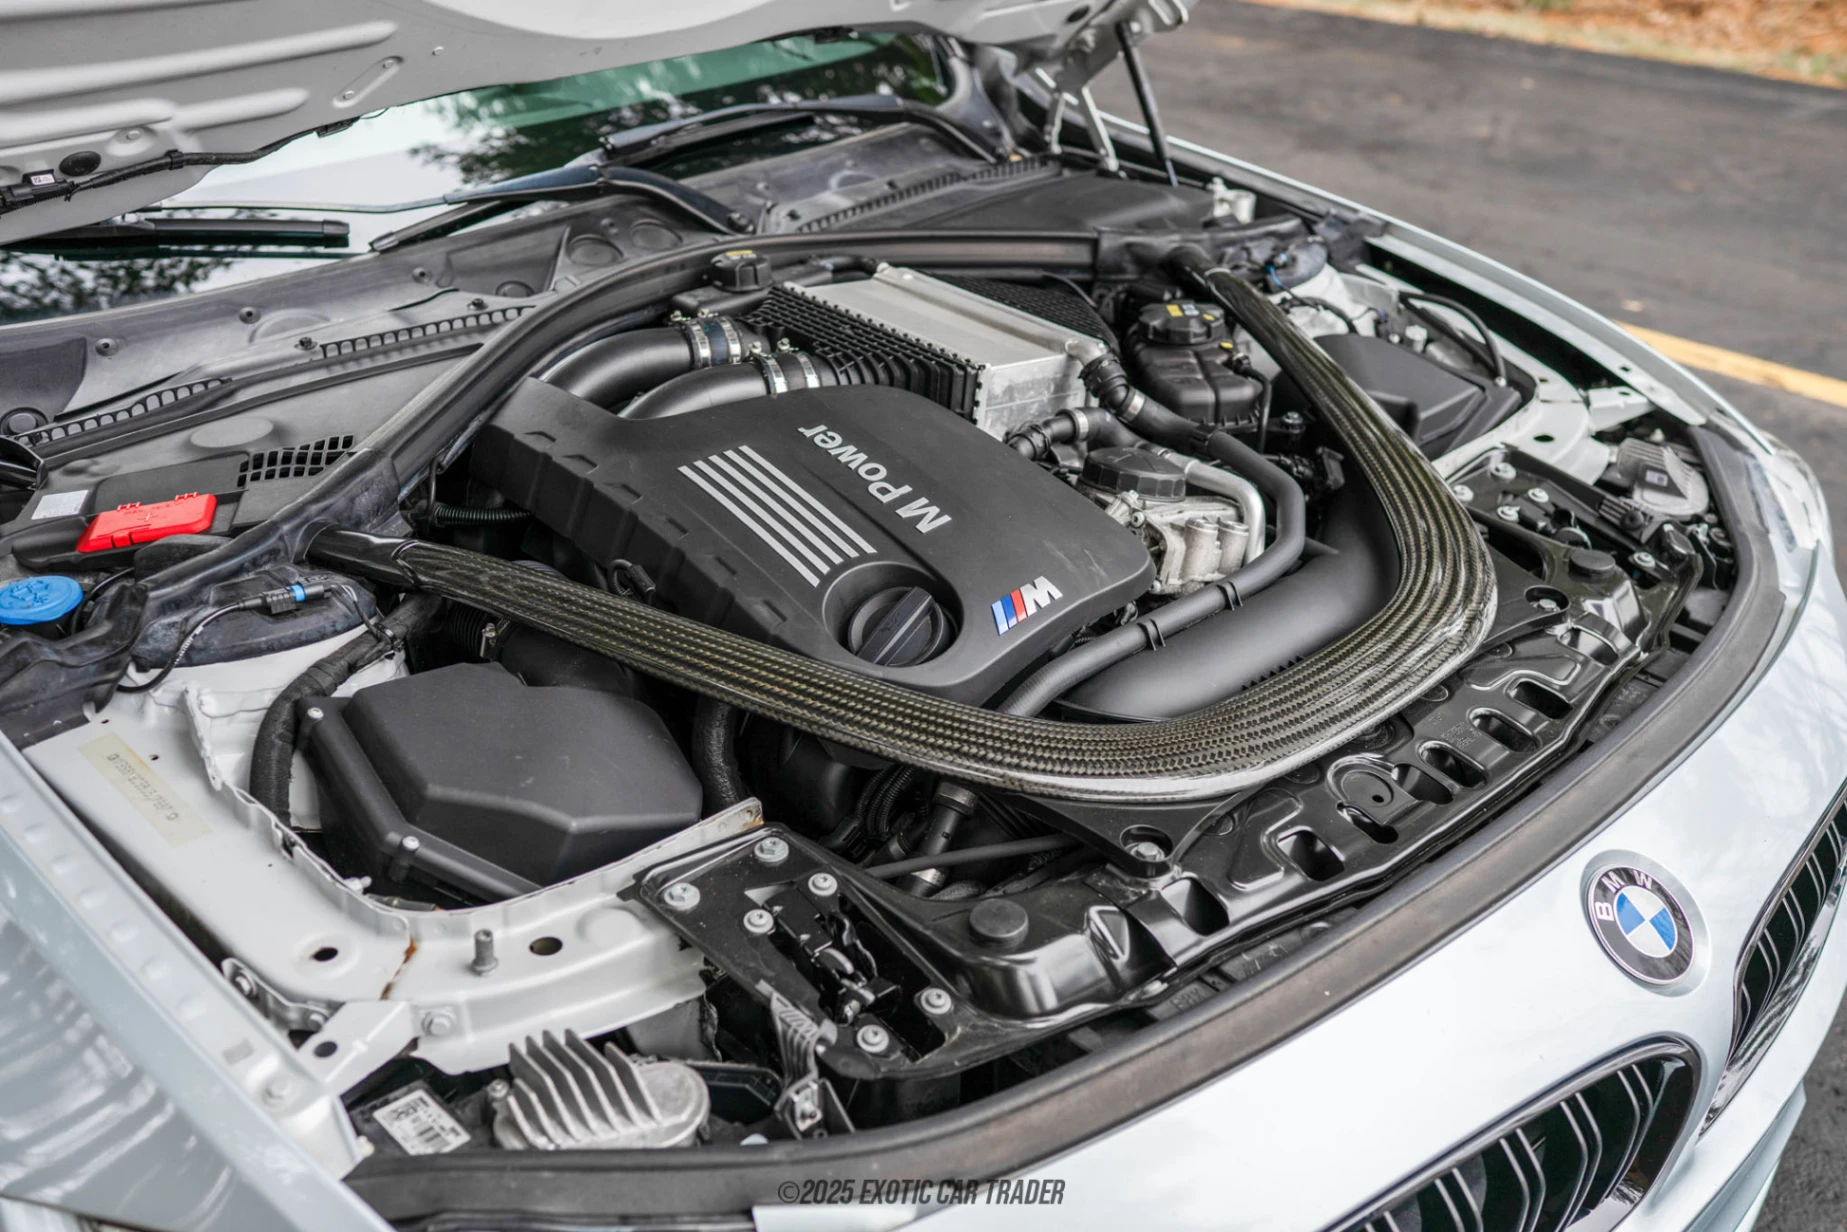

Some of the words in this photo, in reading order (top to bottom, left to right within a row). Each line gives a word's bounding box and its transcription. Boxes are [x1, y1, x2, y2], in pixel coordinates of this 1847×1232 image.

[797, 424, 913, 504] Power
[895, 497, 952, 534] M
[1594, 869, 1653, 922] BMW
